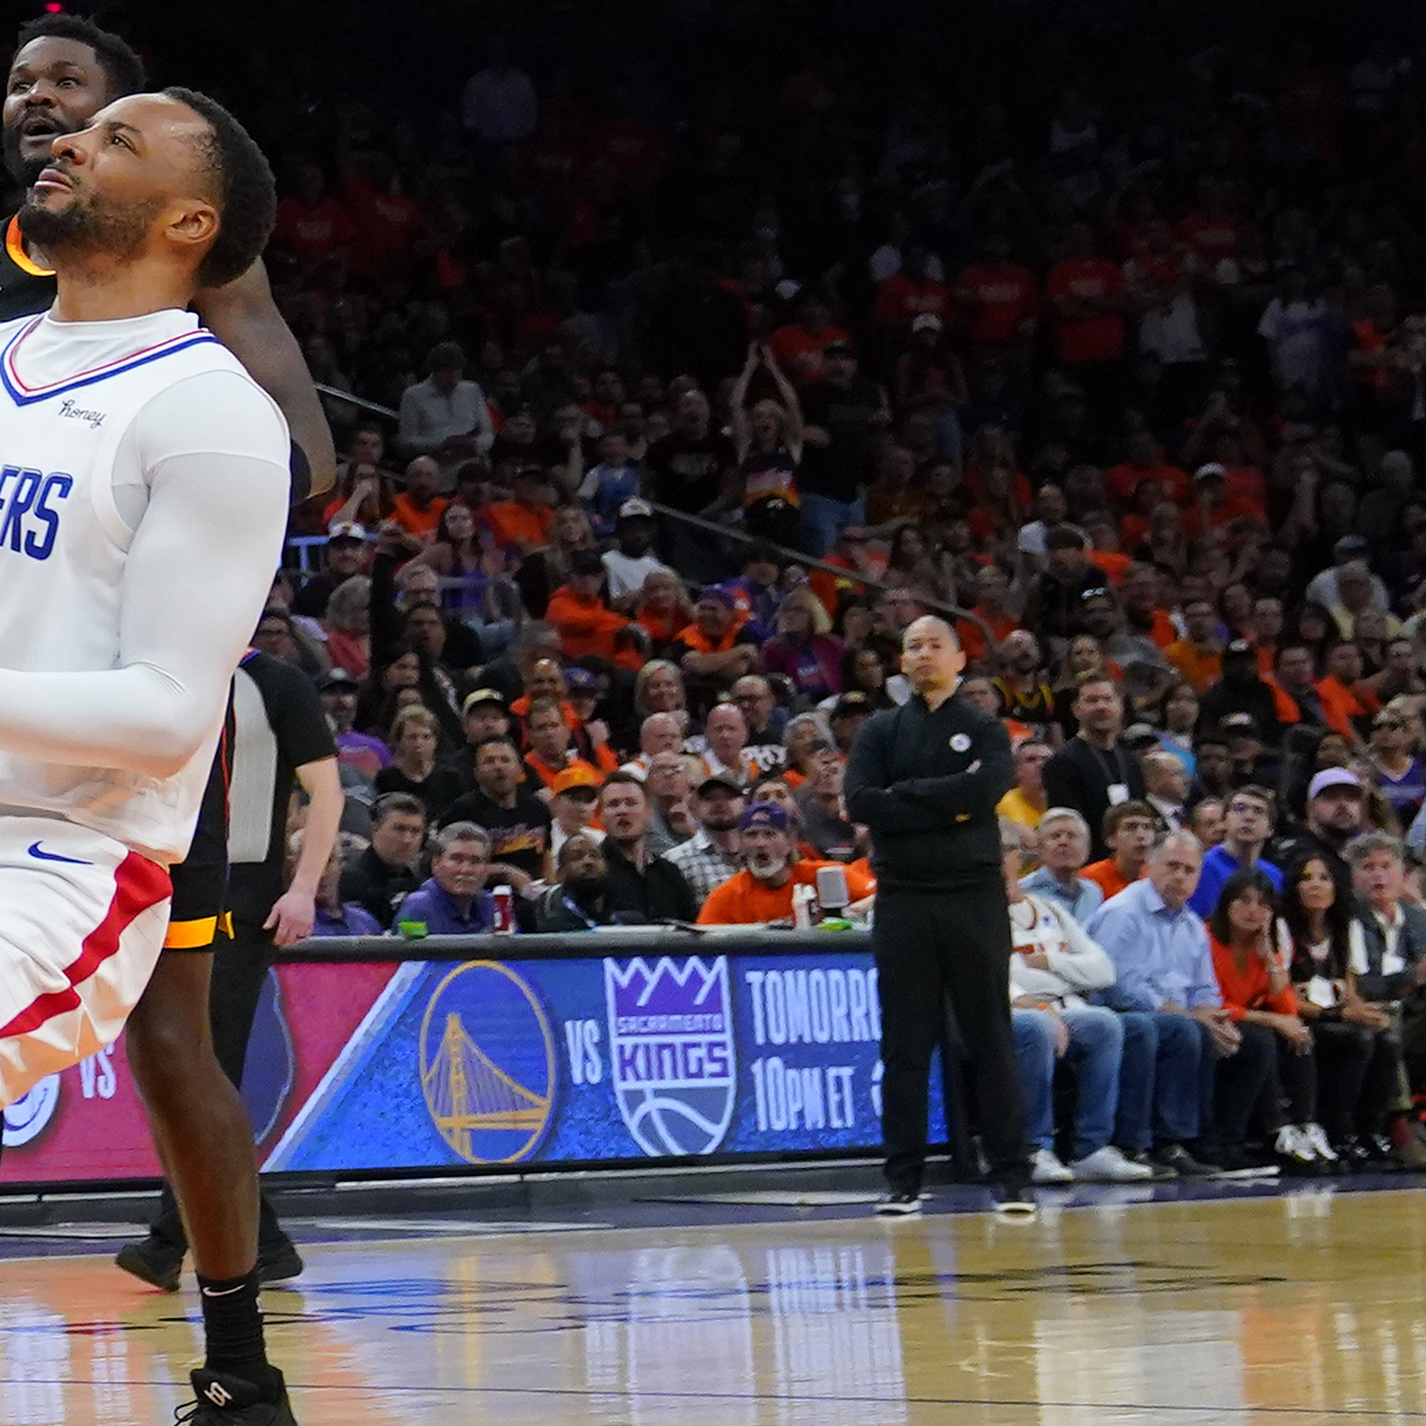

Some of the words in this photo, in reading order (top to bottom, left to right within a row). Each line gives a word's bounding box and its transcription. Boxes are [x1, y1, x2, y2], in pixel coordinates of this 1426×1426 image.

[57, 399, 107, 429] honey
[79, 1041, 116, 1100] VS
[564, 1018, 604, 1086] VS
[618, 1041, 731, 1081] KINGS
[826, 1065, 856, 1129] ET
